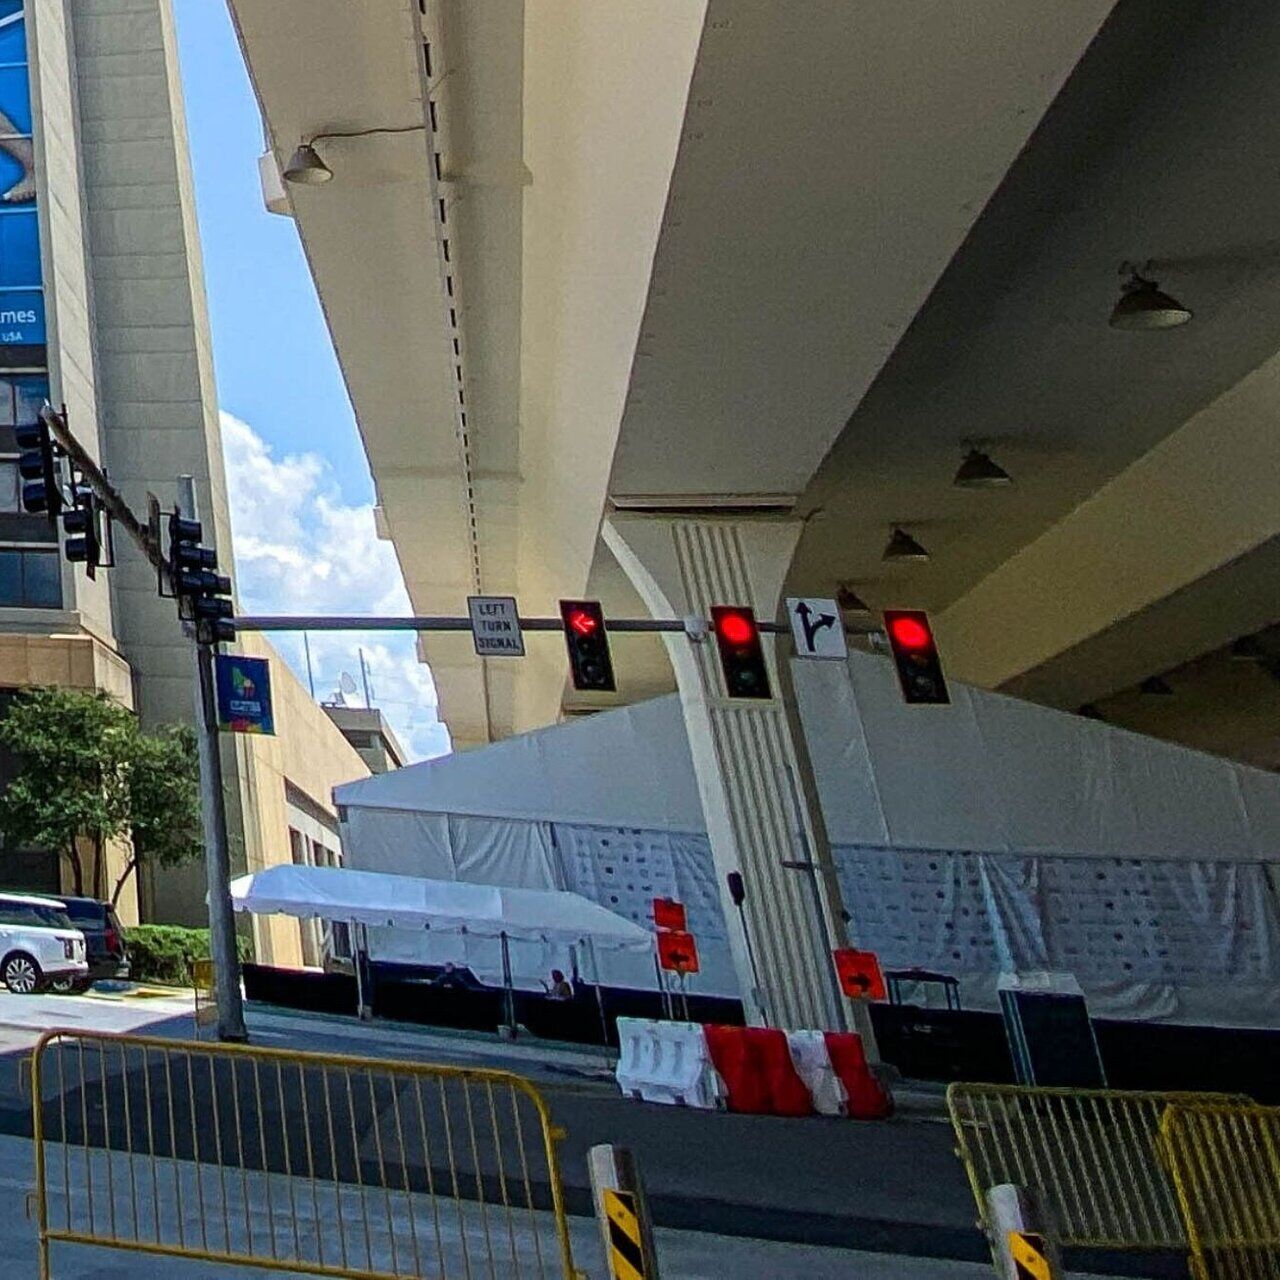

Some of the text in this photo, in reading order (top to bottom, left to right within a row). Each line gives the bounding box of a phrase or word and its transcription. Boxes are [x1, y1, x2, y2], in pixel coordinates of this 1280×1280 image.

[2, 331, 23, 342] USA
[478, 603, 505, 615] LEFT
[481, 620, 512, 632] TURN
[478, 638, 520, 649] SIGNAL
